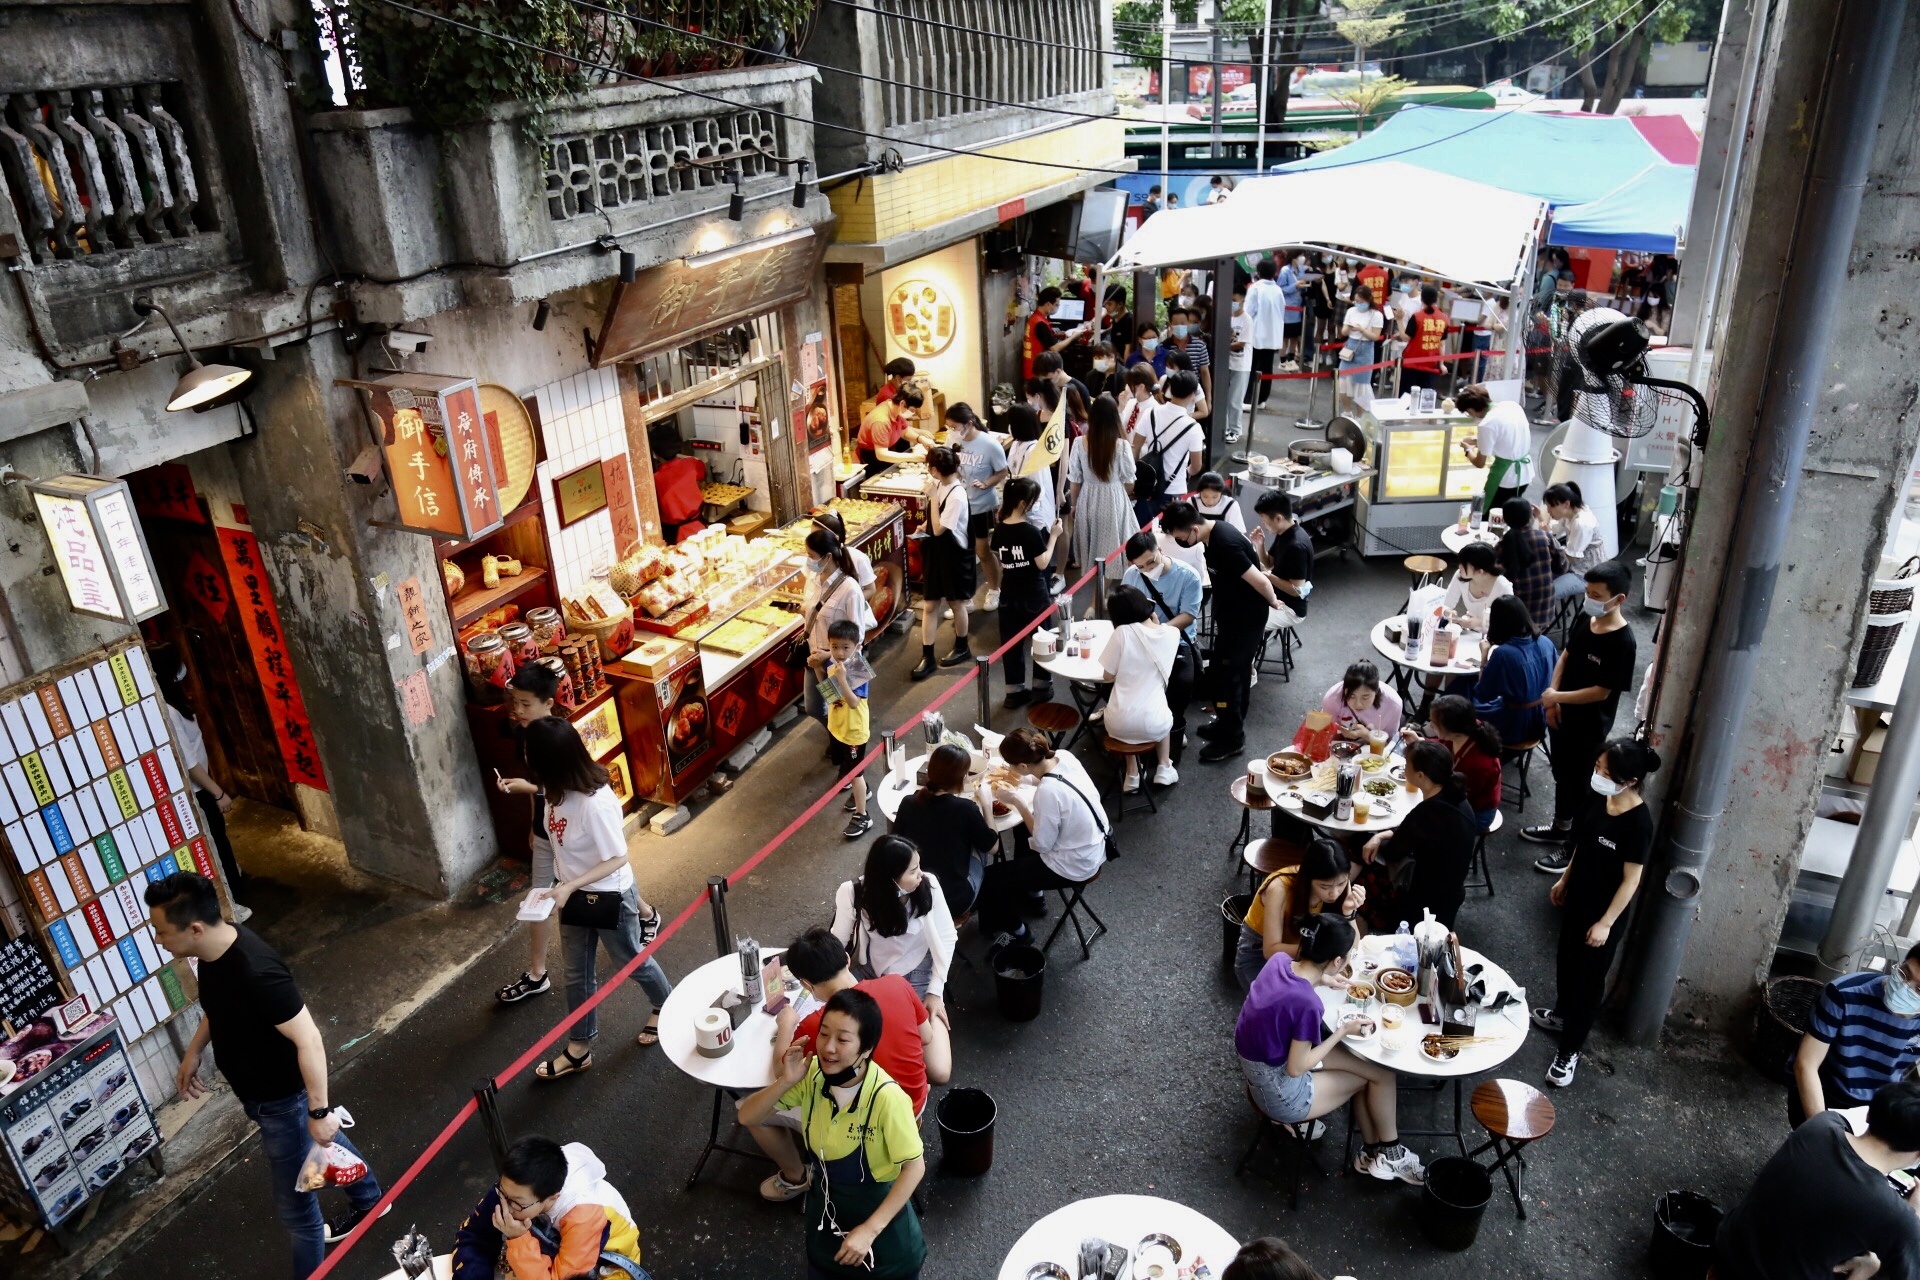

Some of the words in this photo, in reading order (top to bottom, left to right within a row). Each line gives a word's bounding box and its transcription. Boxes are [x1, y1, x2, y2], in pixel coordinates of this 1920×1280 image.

[650, 247, 791, 329] 御手信
[396, 414, 442, 517] 御手信
[457, 411, 490, 510] 廣府傳承
[52, 502, 110, 611] 炖品皇
[998, 545, 1026, 561] 广州
[984, 748, 990, 760] 5
[716, 1027, 731, 1045] 10
